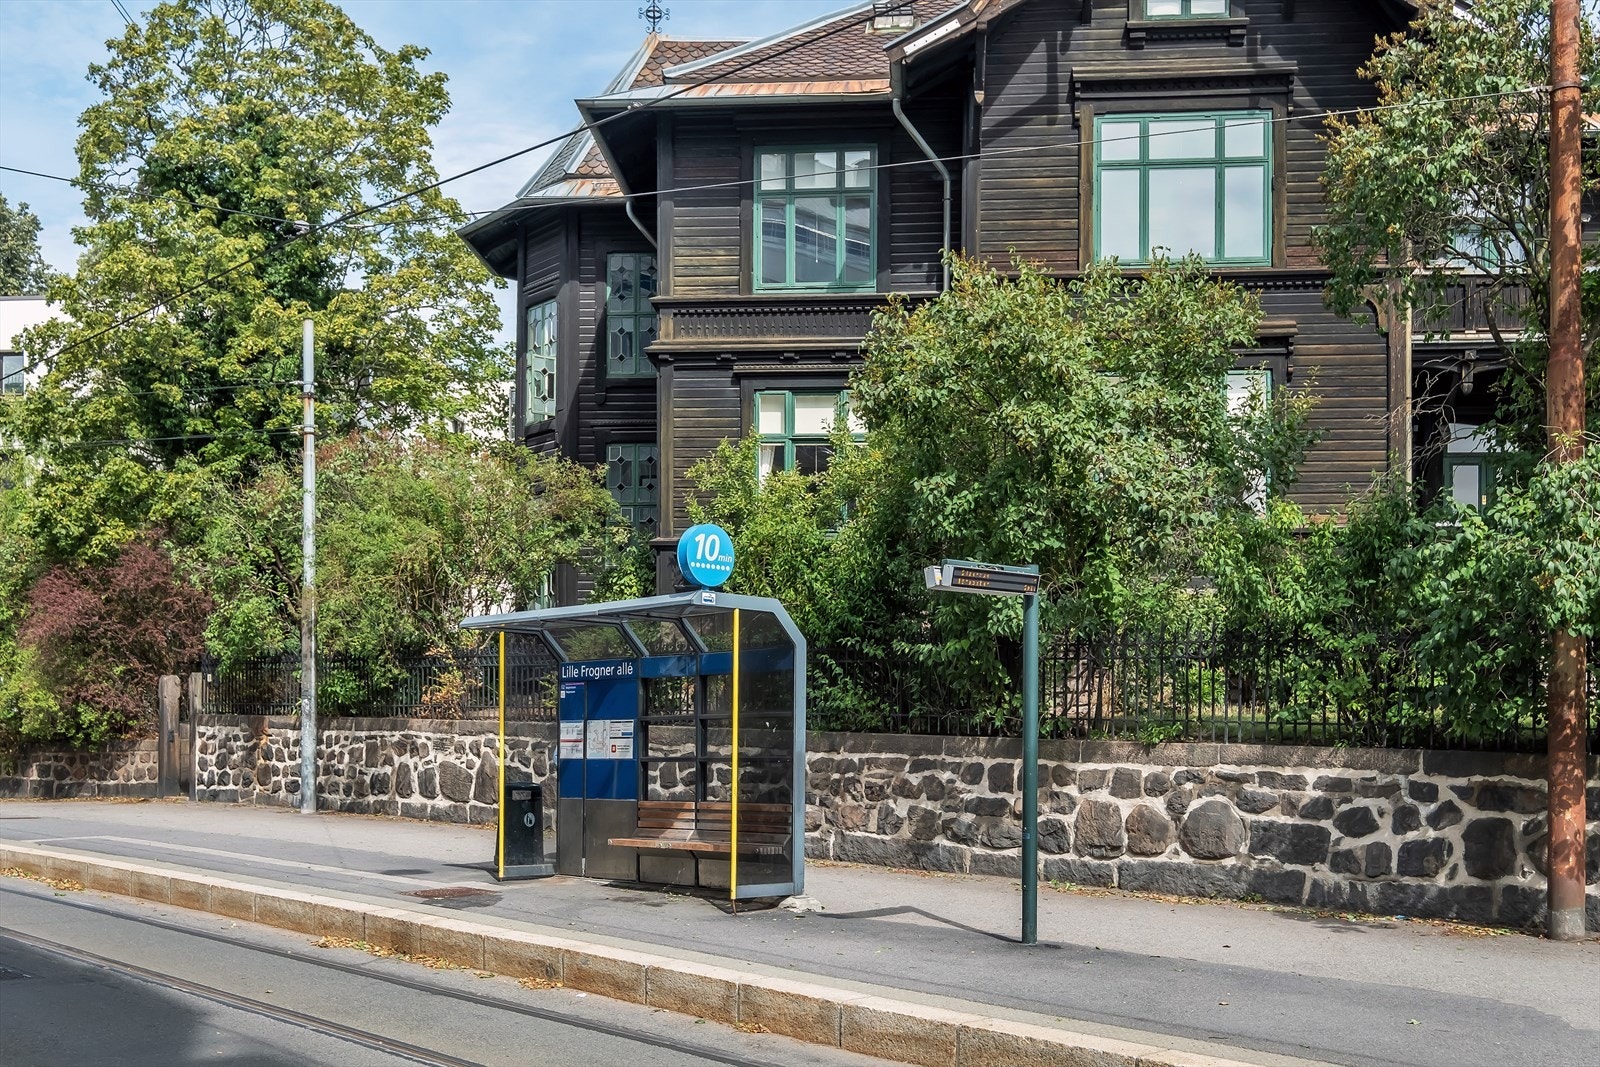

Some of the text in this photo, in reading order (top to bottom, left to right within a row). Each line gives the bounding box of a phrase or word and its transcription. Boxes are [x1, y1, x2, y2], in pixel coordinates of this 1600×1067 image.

[694, 533, 733, 563] 10 min
[562, 662, 633, 680] Lille Frogner allé
